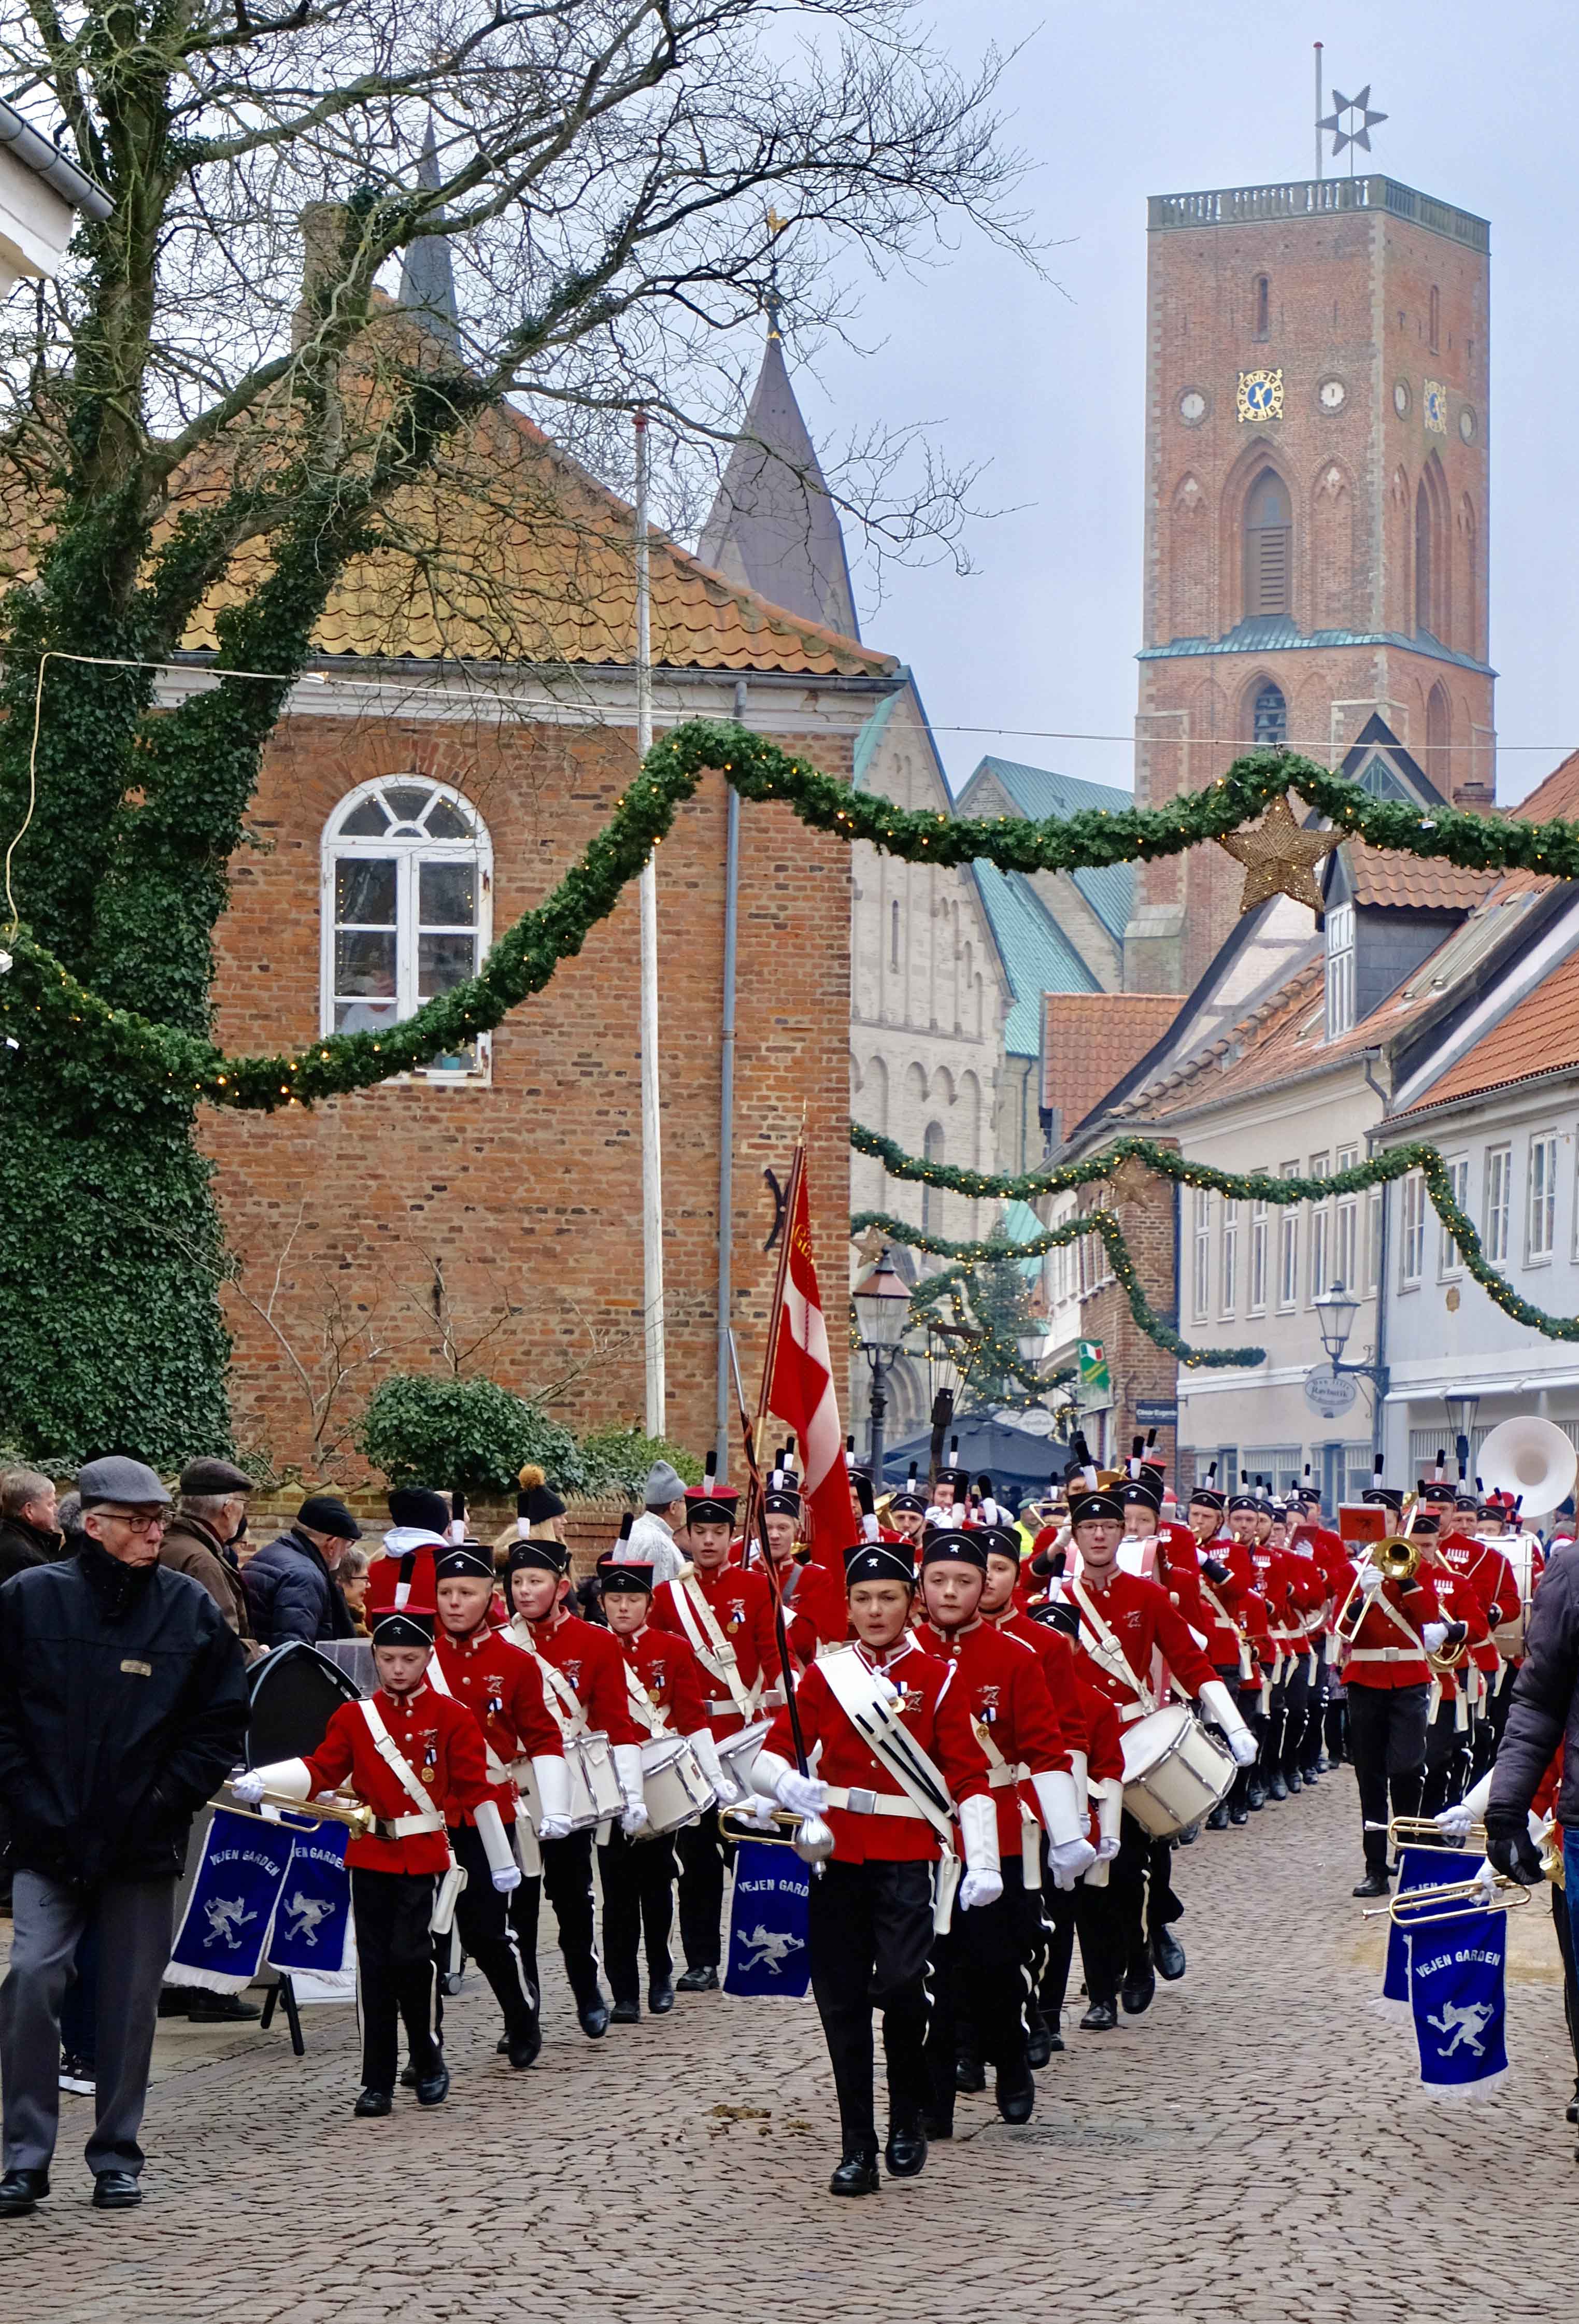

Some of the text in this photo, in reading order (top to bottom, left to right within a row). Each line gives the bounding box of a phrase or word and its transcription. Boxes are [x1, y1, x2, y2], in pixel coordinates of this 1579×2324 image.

[209, 1849, 281, 1877] VEJEN GARDEN
[737, 1879, 809, 1897] VEJEN GARD
[1415, 1949, 1501, 1978] VEJEN GARDEN
